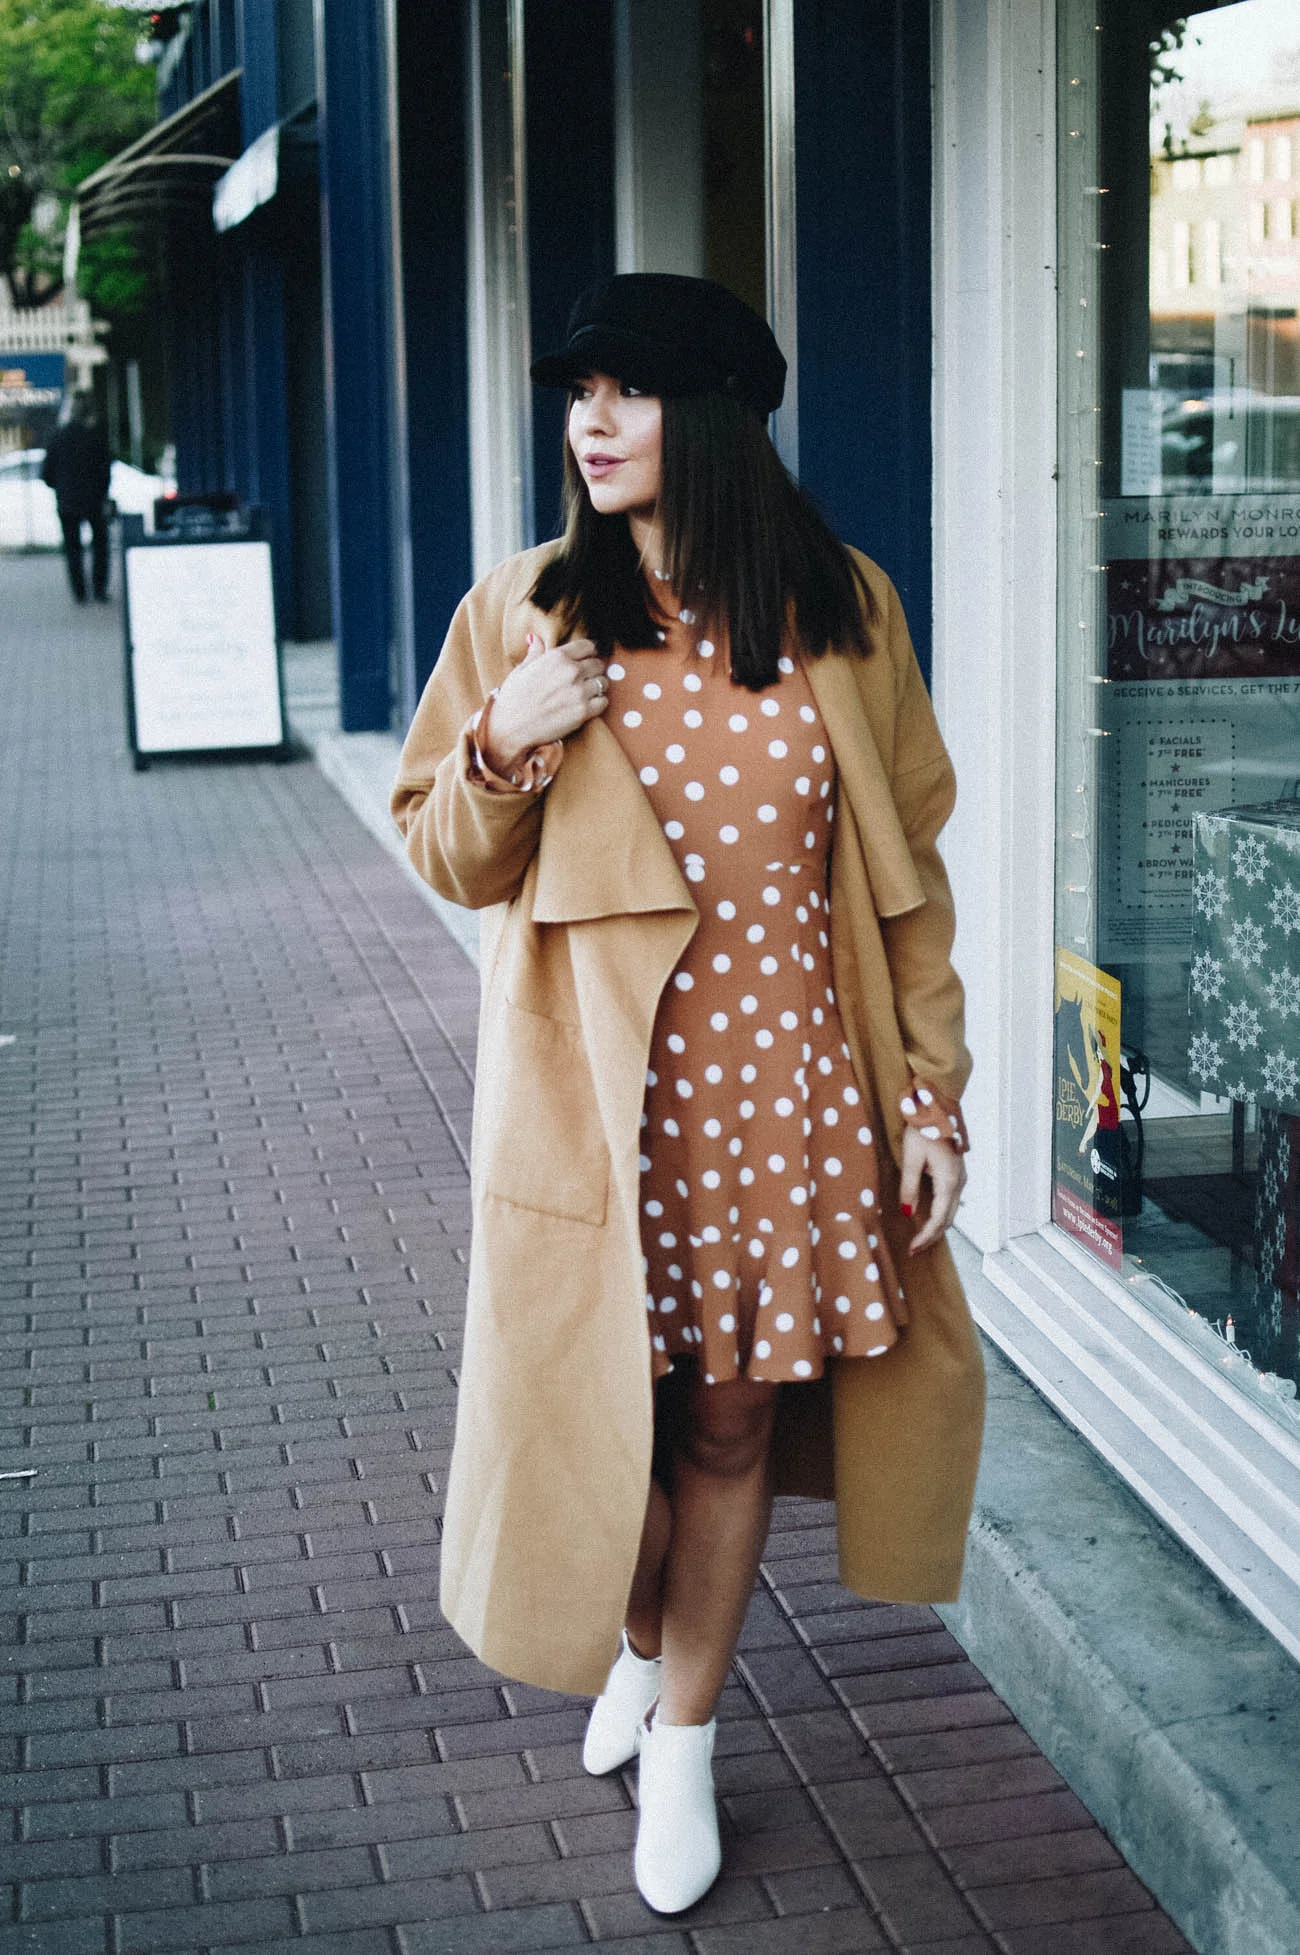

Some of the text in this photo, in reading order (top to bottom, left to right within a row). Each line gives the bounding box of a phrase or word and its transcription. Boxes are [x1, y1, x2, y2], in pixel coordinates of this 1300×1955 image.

[1124, 508, 1300, 523] MARILYN MONR
[1158, 526, 1300, 541] REWARDS YOUR LO
[1183, 583, 1242, 602] INTRODUCING
[1107, 602, 1266, 659] Marilyn's
[1114, 687, 1164, 698] RECEIVE
[1167, 685, 1174, 696] 6
[1177, 685, 1237, 697] SERVICES,
[1241, 684, 1264, 695] GET
[1268, 683, 1289, 694] THE
[1160, 736, 1201, 745] FACIALS
[1150, 777, 1210, 786] MANICURES
[1146, 859, 1177, 868] BROW
[1056, 1100, 1085, 1129] DERBY
